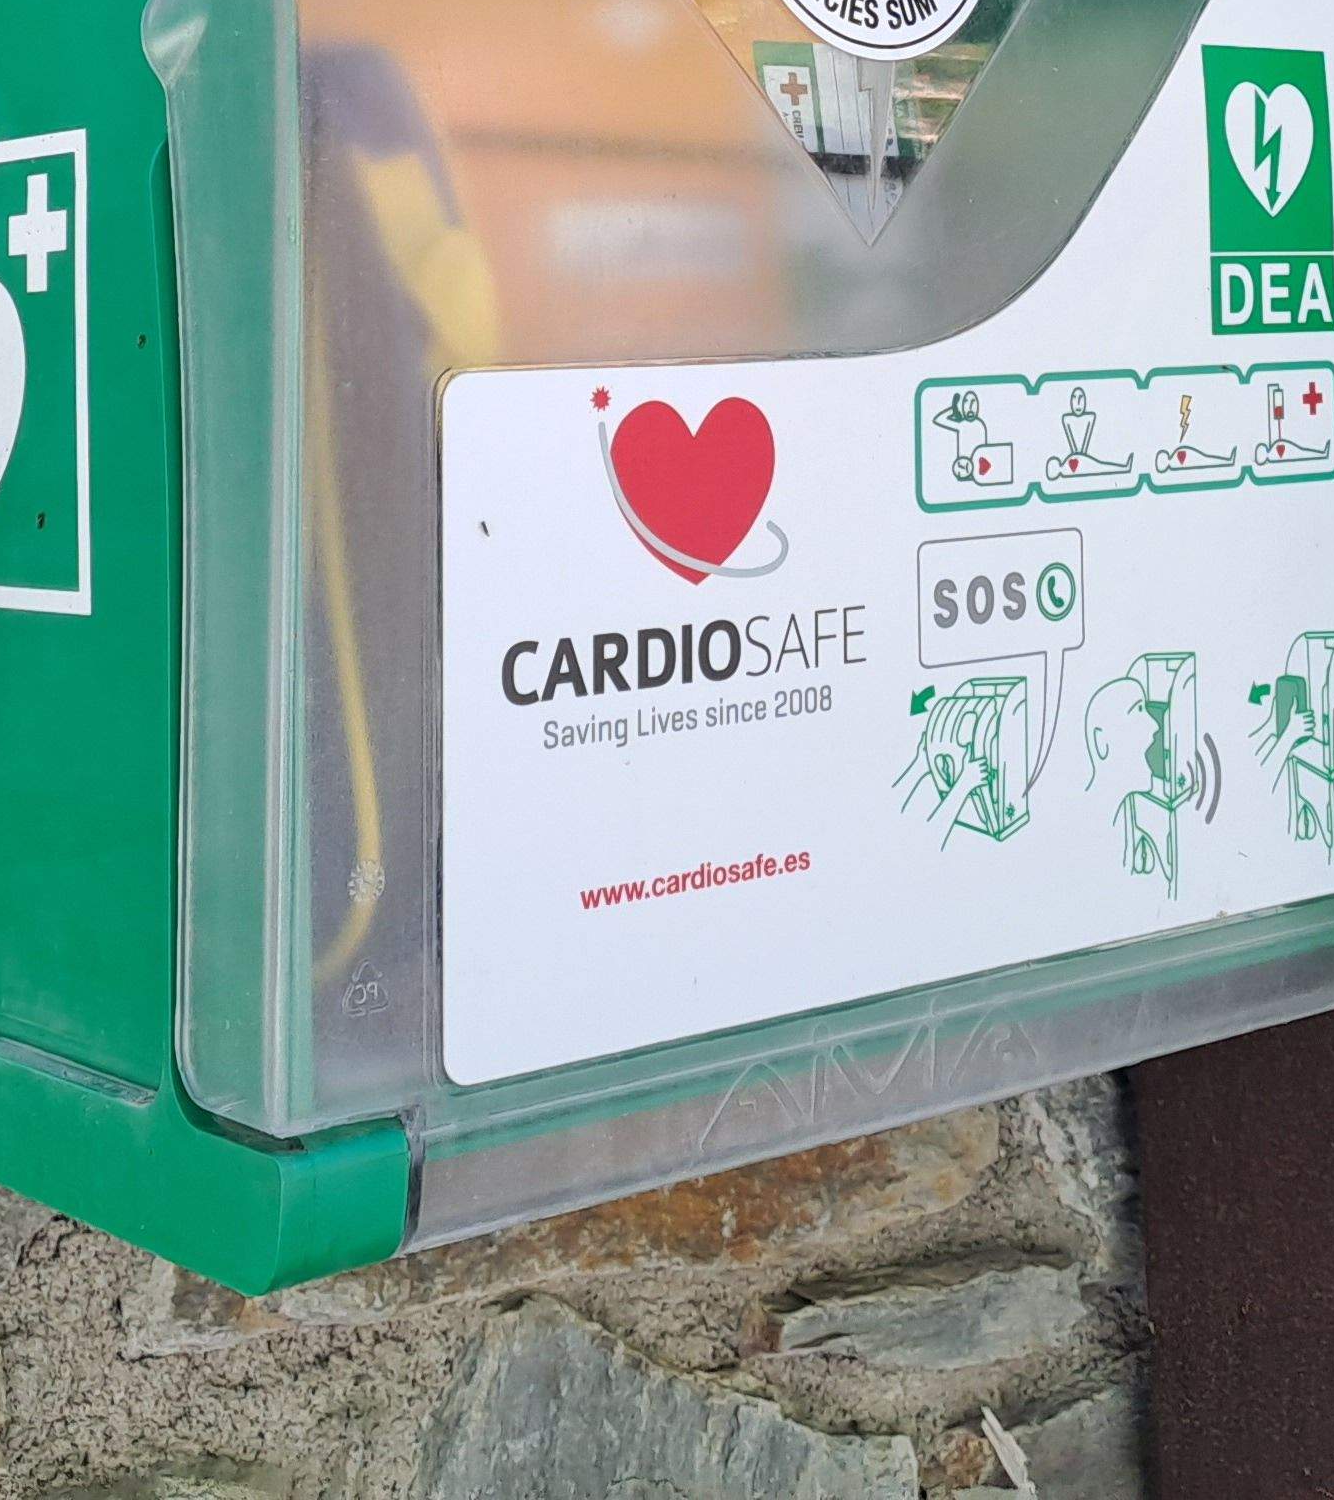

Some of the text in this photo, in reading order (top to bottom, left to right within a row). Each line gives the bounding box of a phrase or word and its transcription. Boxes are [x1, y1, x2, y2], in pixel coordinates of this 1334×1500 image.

[1219, 263, 1334, 328] DEA
[933, 570, 1028, 630] SOS
[500, 604, 867, 707] CARDIOSAFE
[543, 684, 834, 750] Saving Lives since 2008
[579, 850, 812, 911] www.cardiosafe.es
